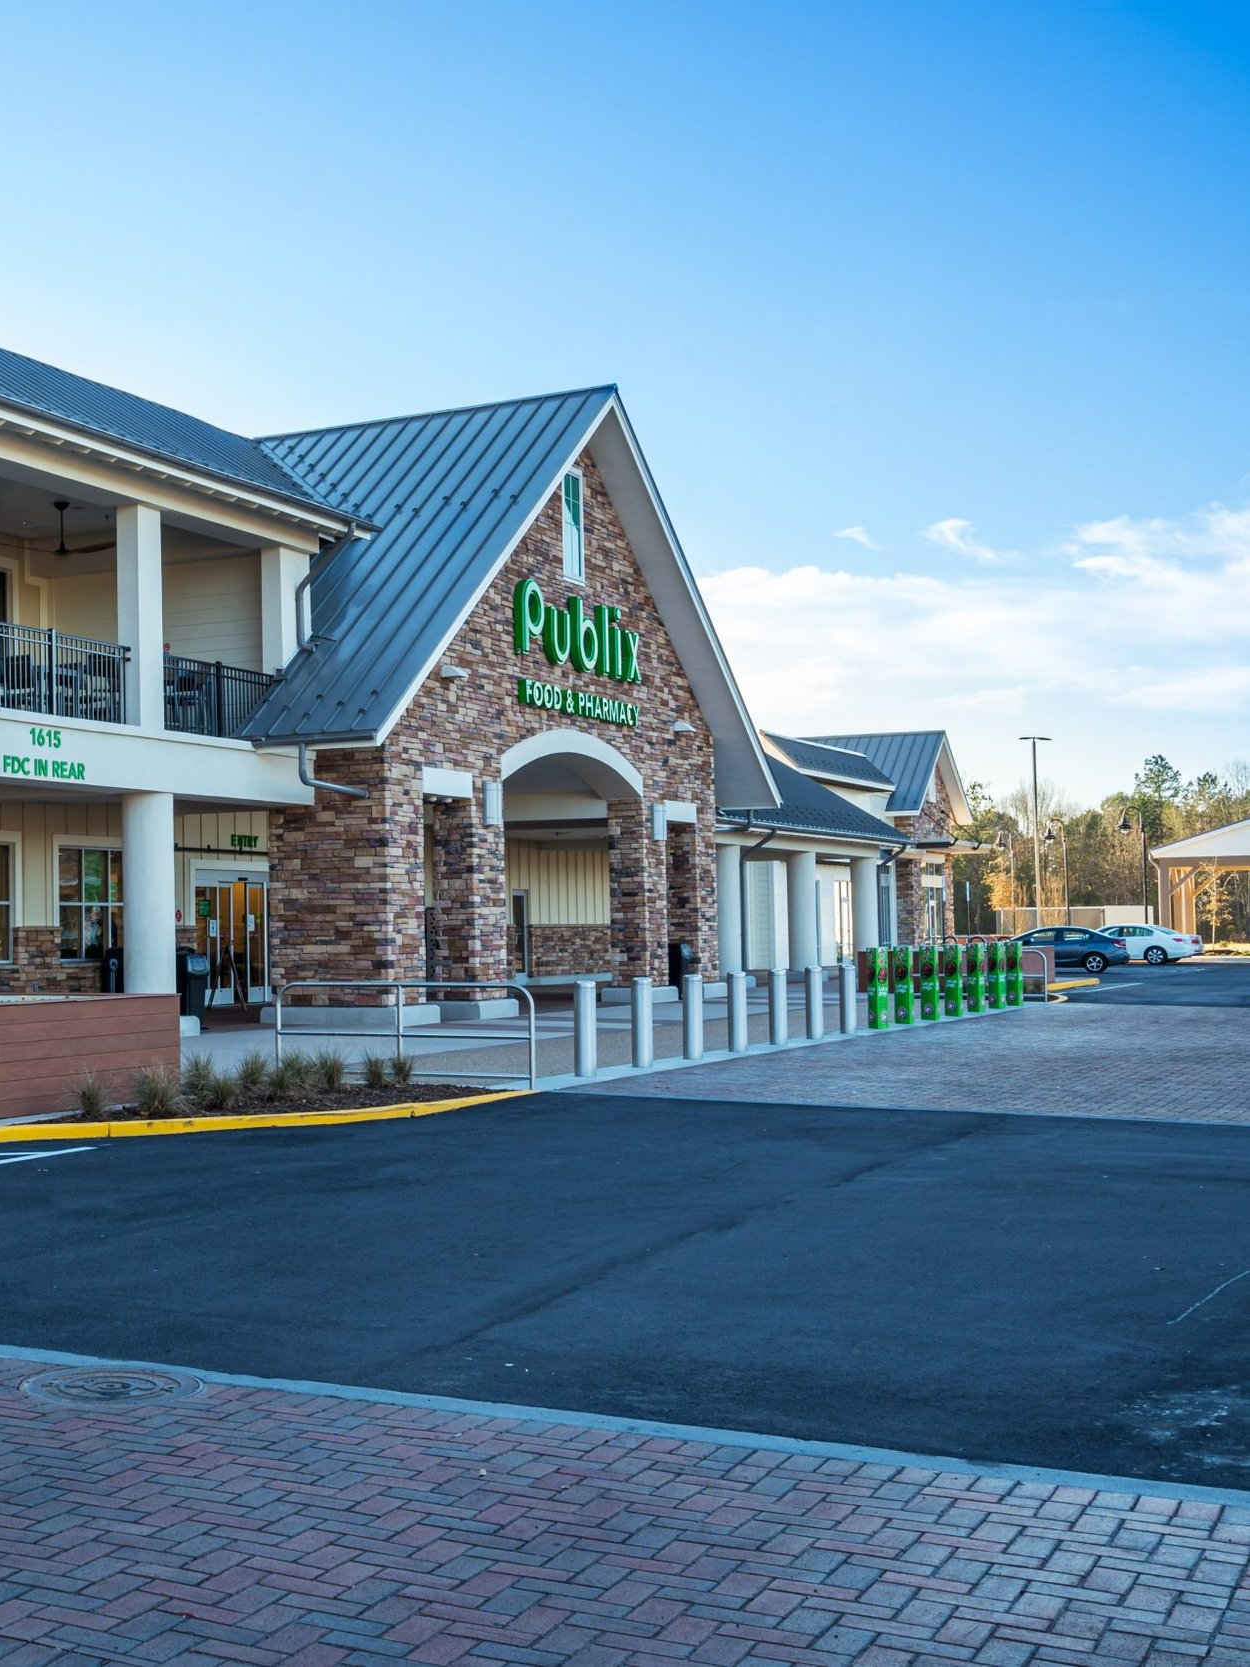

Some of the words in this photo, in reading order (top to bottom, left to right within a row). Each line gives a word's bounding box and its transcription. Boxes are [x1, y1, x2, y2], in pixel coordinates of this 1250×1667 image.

[514, 578, 641, 683] Publix
[519, 679, 562, 710] FOOD
[566, 689, 575, 714] &
[578, 693, 639, 727] PHARMACY
[30, 727, 62, 749] 1615
[3, 754, 31, 776] FDC
[34, 758, 48, 777] IN
[52, 760, 86, 780] REAR
[231, 834, 259, 848] ENTRY
